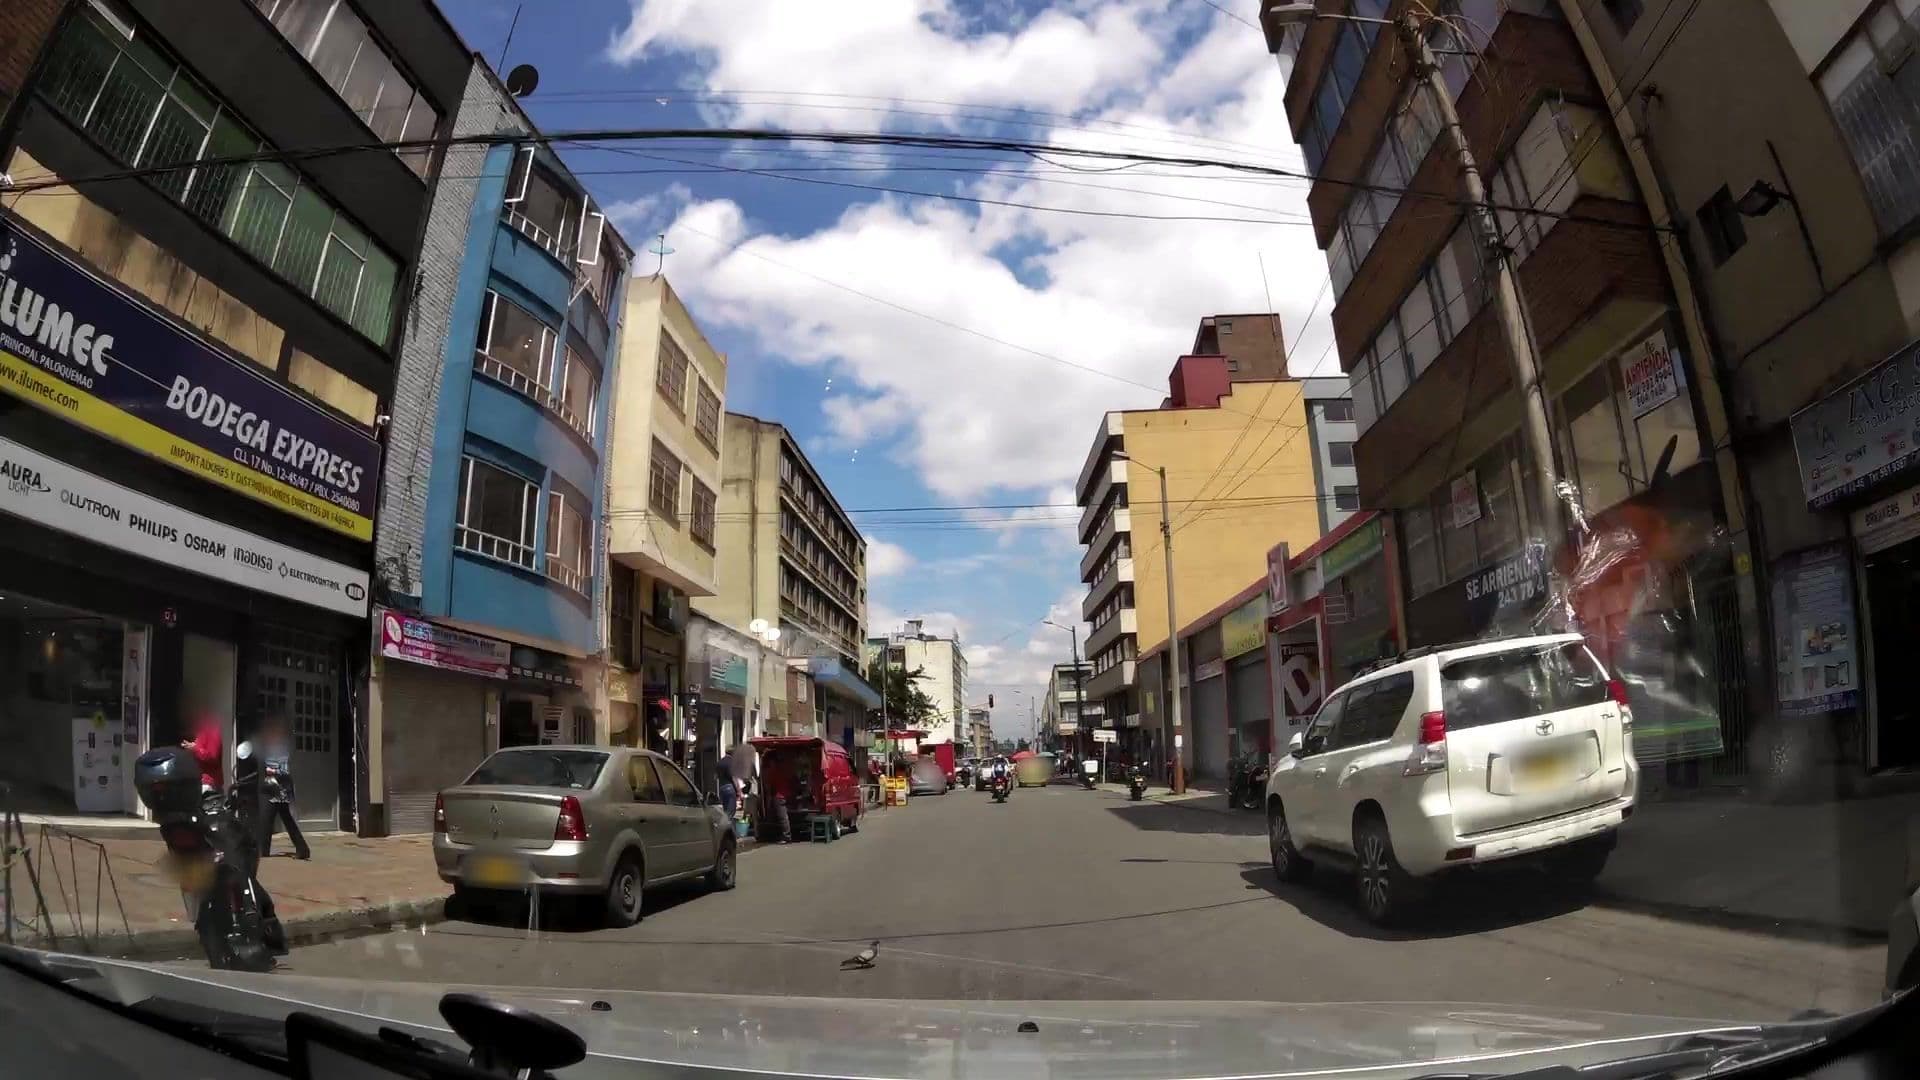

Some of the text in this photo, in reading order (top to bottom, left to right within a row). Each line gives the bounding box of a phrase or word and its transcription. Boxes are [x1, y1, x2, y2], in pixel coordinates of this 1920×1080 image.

[0, 264, 114, 377] LUMEC
[0, 332, 94, 389] PRINCIPAL PALOQUEMAO
[166, 374, 364, 494] BODEGA EXPRESS
[0, 460, 42, 489] AURA
[170, 444, 229, 481] IMPORTADORES
[229, 470, 236, 482] Y
[233, 447, 249, 465] CLL
[250, 455, 261, 471] 17
[8, 479, 31, 497] LIGHT
[130, 514, 178, 543] PHILIPS
[184, 533, 226, 559] OSRAM
[1465, 578, 1480, 601] SE
